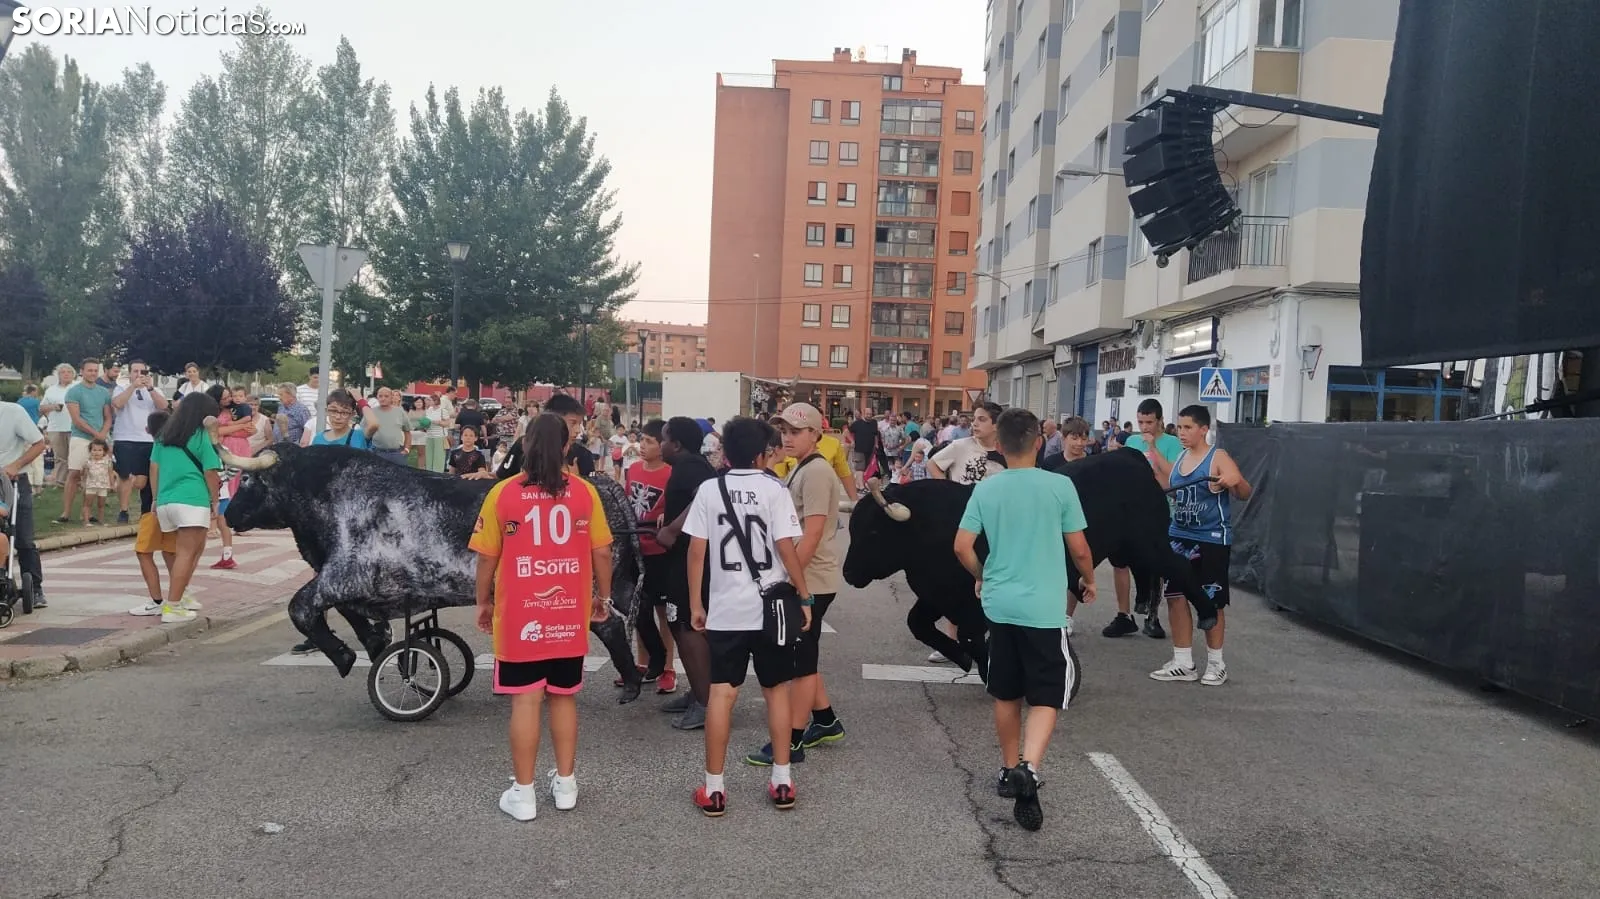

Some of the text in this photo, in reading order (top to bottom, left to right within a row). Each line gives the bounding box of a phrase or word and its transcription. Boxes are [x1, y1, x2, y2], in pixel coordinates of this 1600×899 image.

[521, 492, 538, 500] SAN
[525, 504, 571, 546] 10
[718, 513, 773, 571] 20
[534, 560, 580, 576] Soria
[545, 624, 564, 632] Soria
